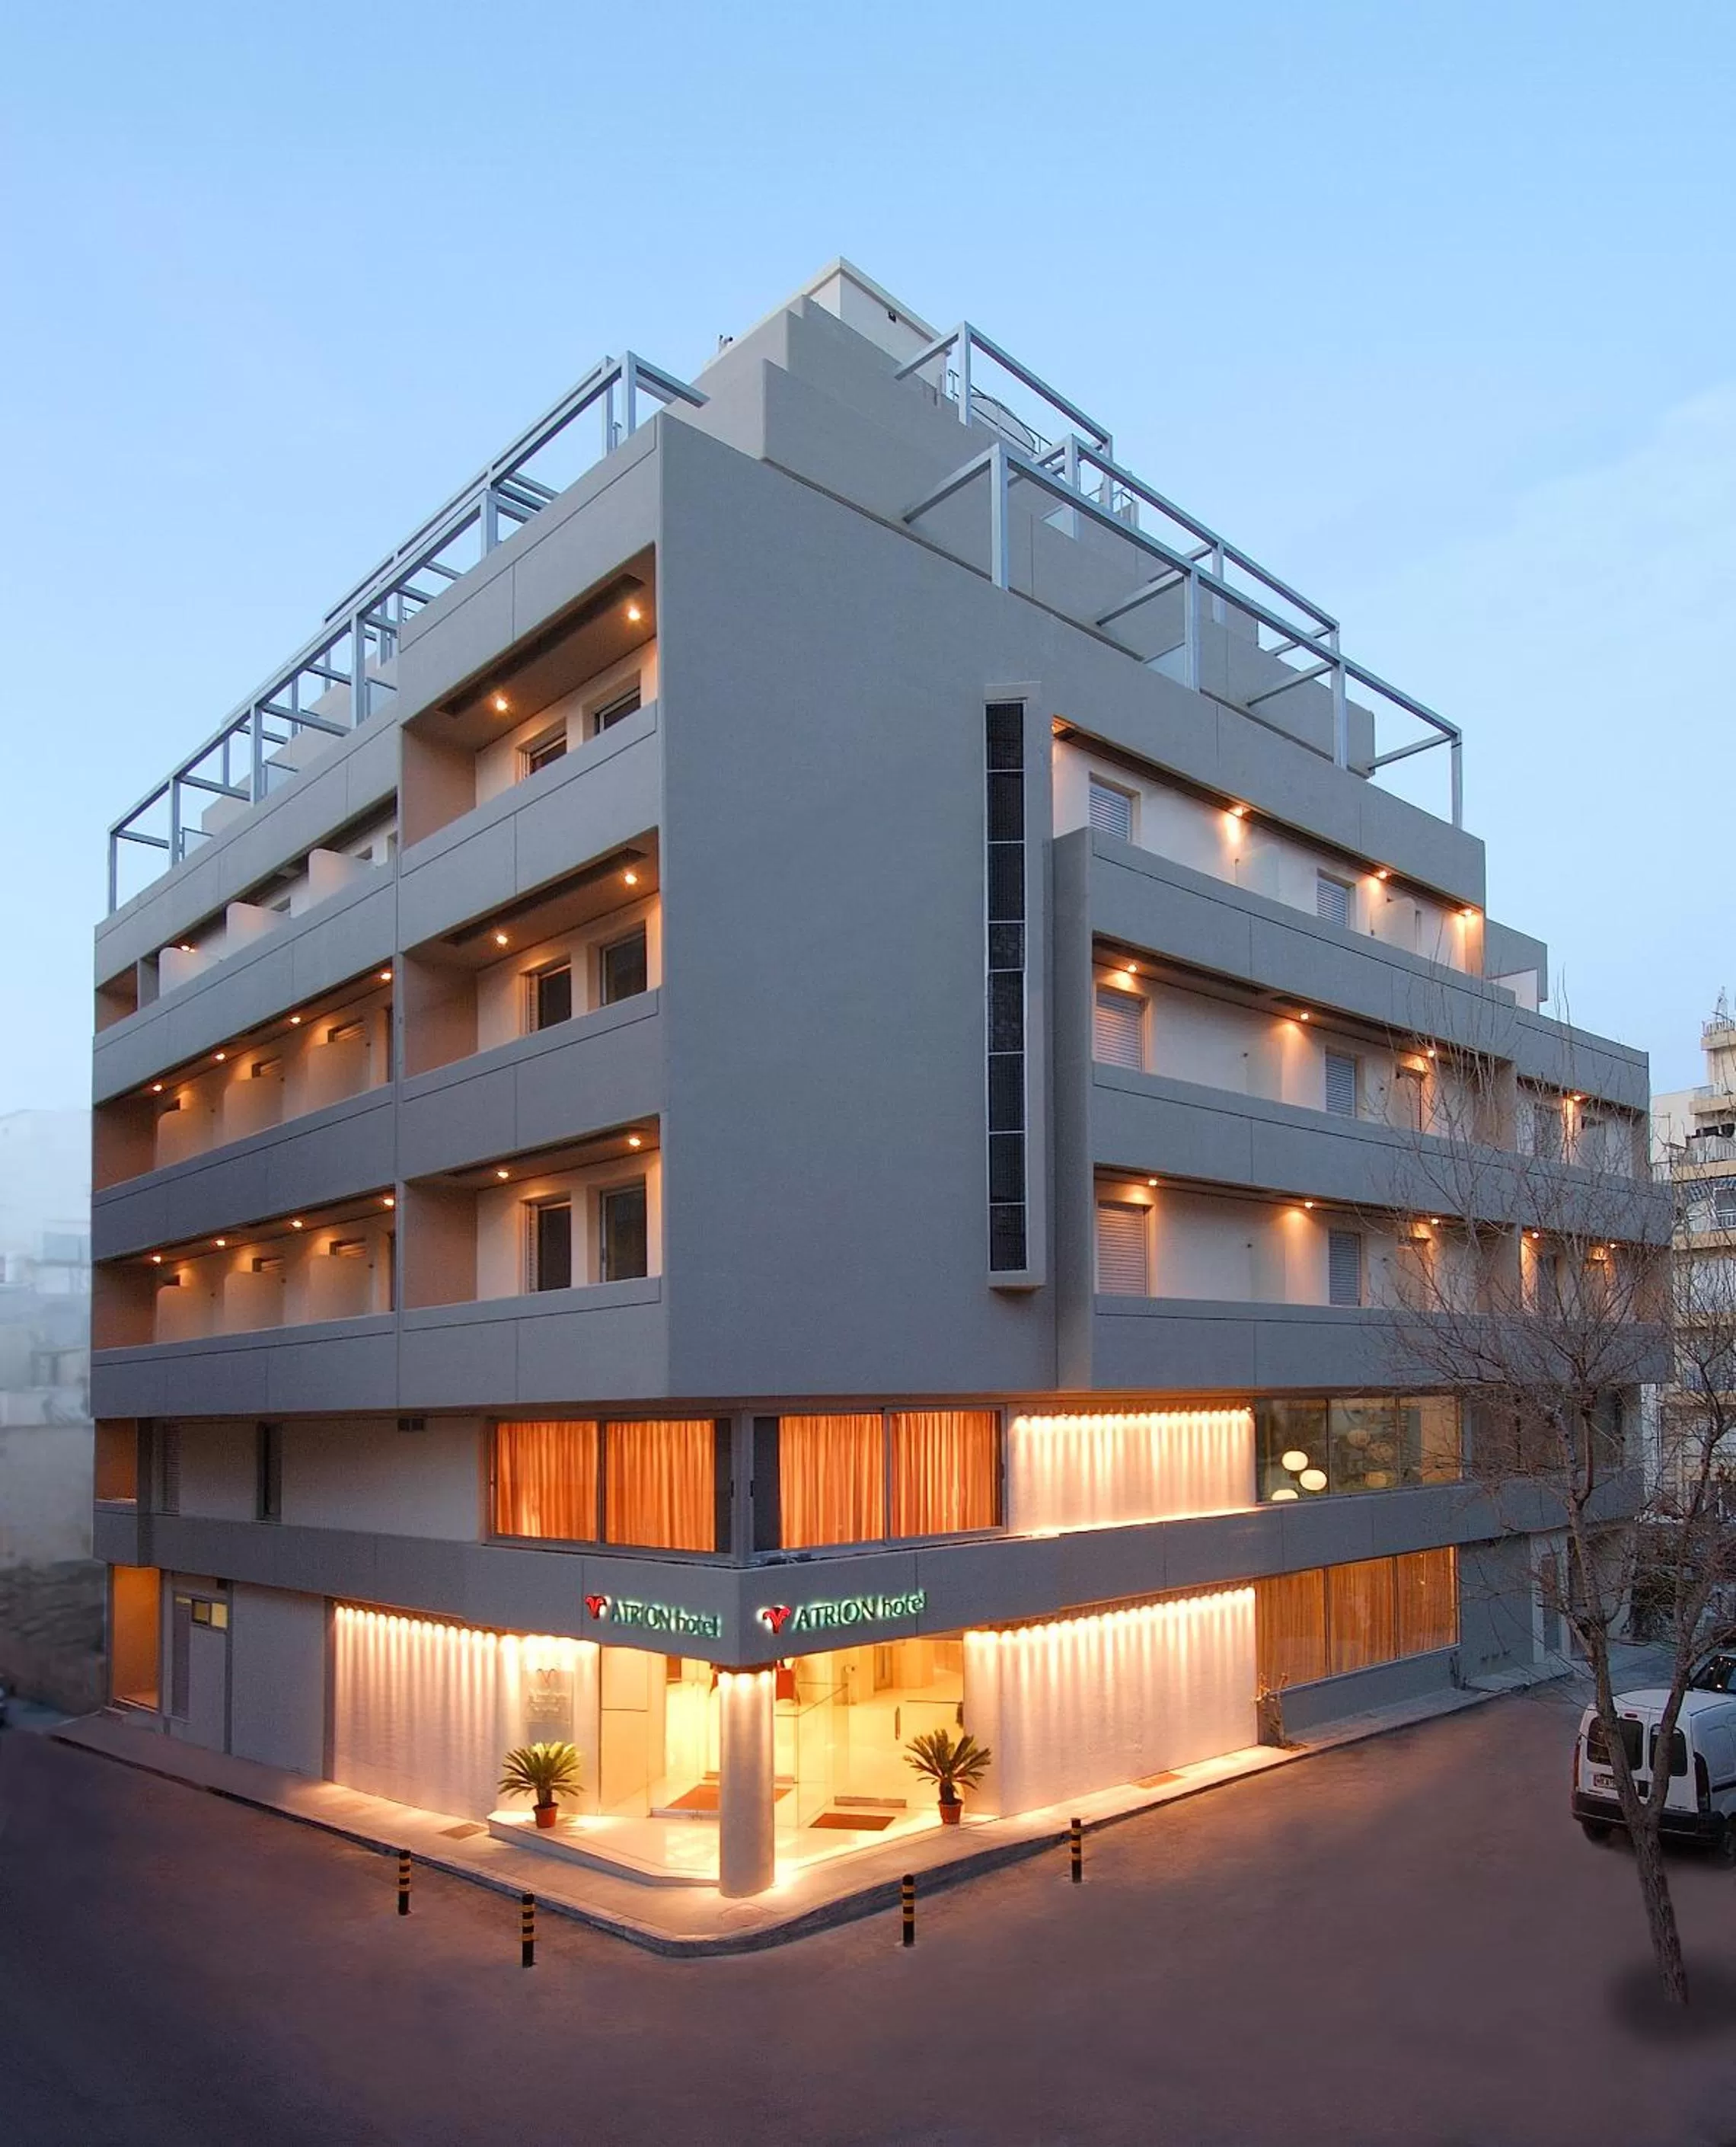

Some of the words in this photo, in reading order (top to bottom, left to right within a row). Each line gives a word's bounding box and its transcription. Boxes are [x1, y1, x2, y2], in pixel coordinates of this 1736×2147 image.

[611, 1601, 672, 1631] ATRION
[675, 1609, 720, 1637] hotel
[795, 1599, 875, 1629] ATRION
[881, 1590, 927, 1617] hotel
